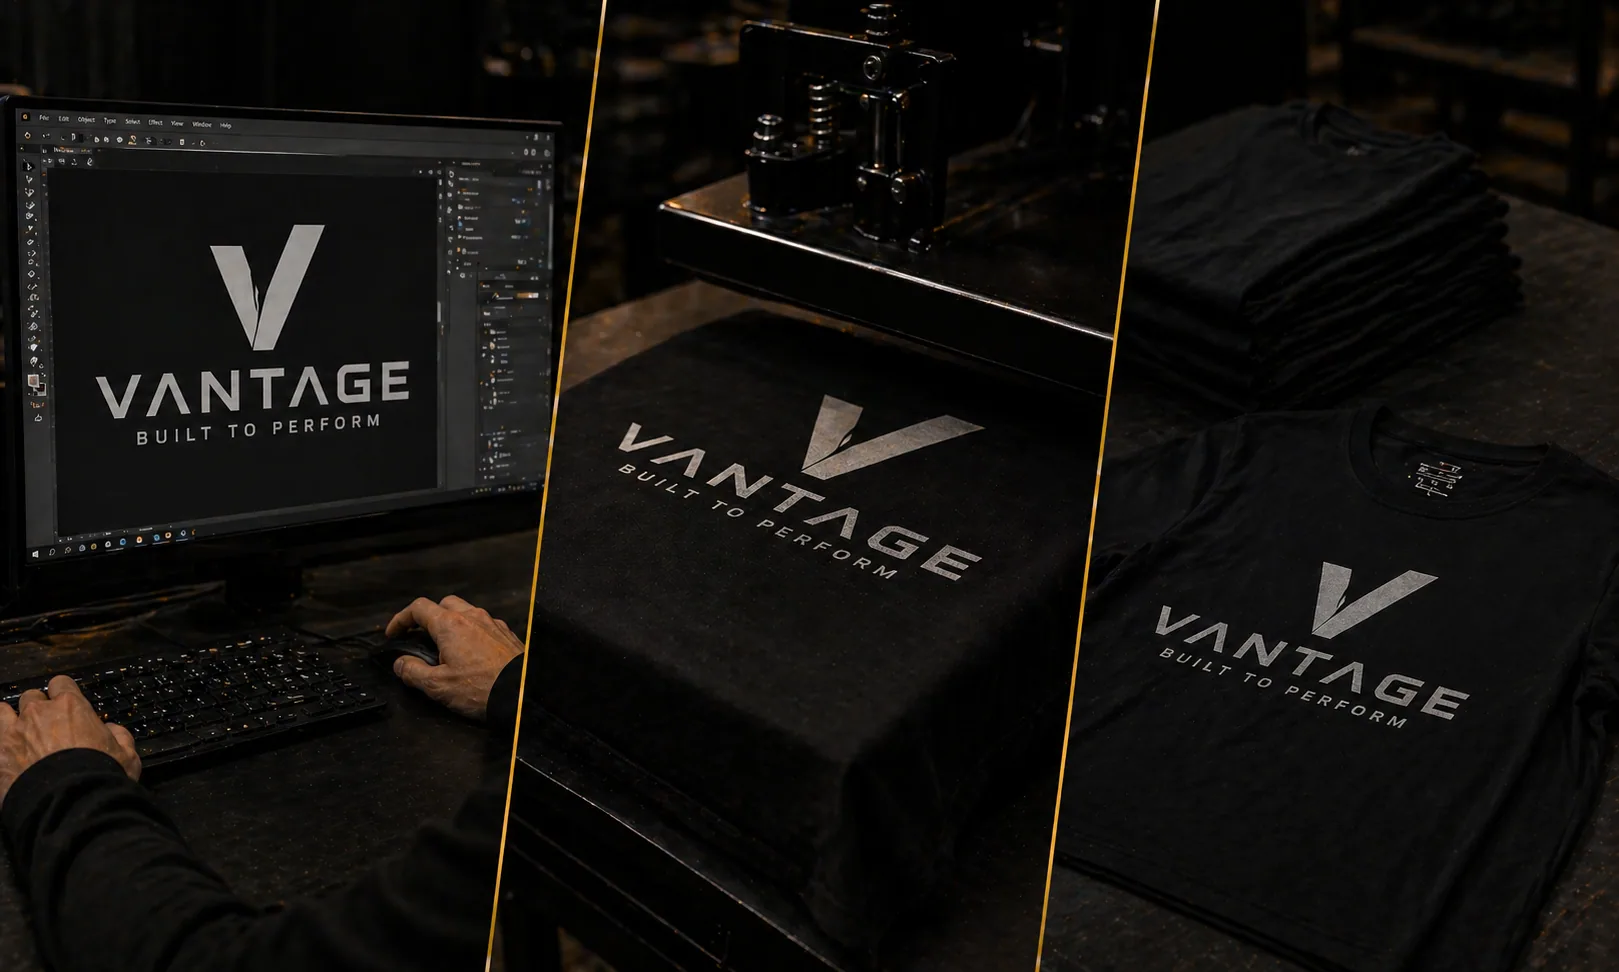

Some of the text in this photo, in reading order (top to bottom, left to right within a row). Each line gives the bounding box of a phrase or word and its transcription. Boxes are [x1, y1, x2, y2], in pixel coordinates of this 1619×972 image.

[96, 361, 409, 418] VANTAGE
[137, 414, 379, 445] BUILT TO PERFORM
[618, 465, 897, 579] BUILT TO PERFORM
[619, 422, 982, 581] VANTAGE
[1155, 605, 1470, 720] VANTAGE
[1160, 648, 1407, 728] BUILT TO PERFORM
